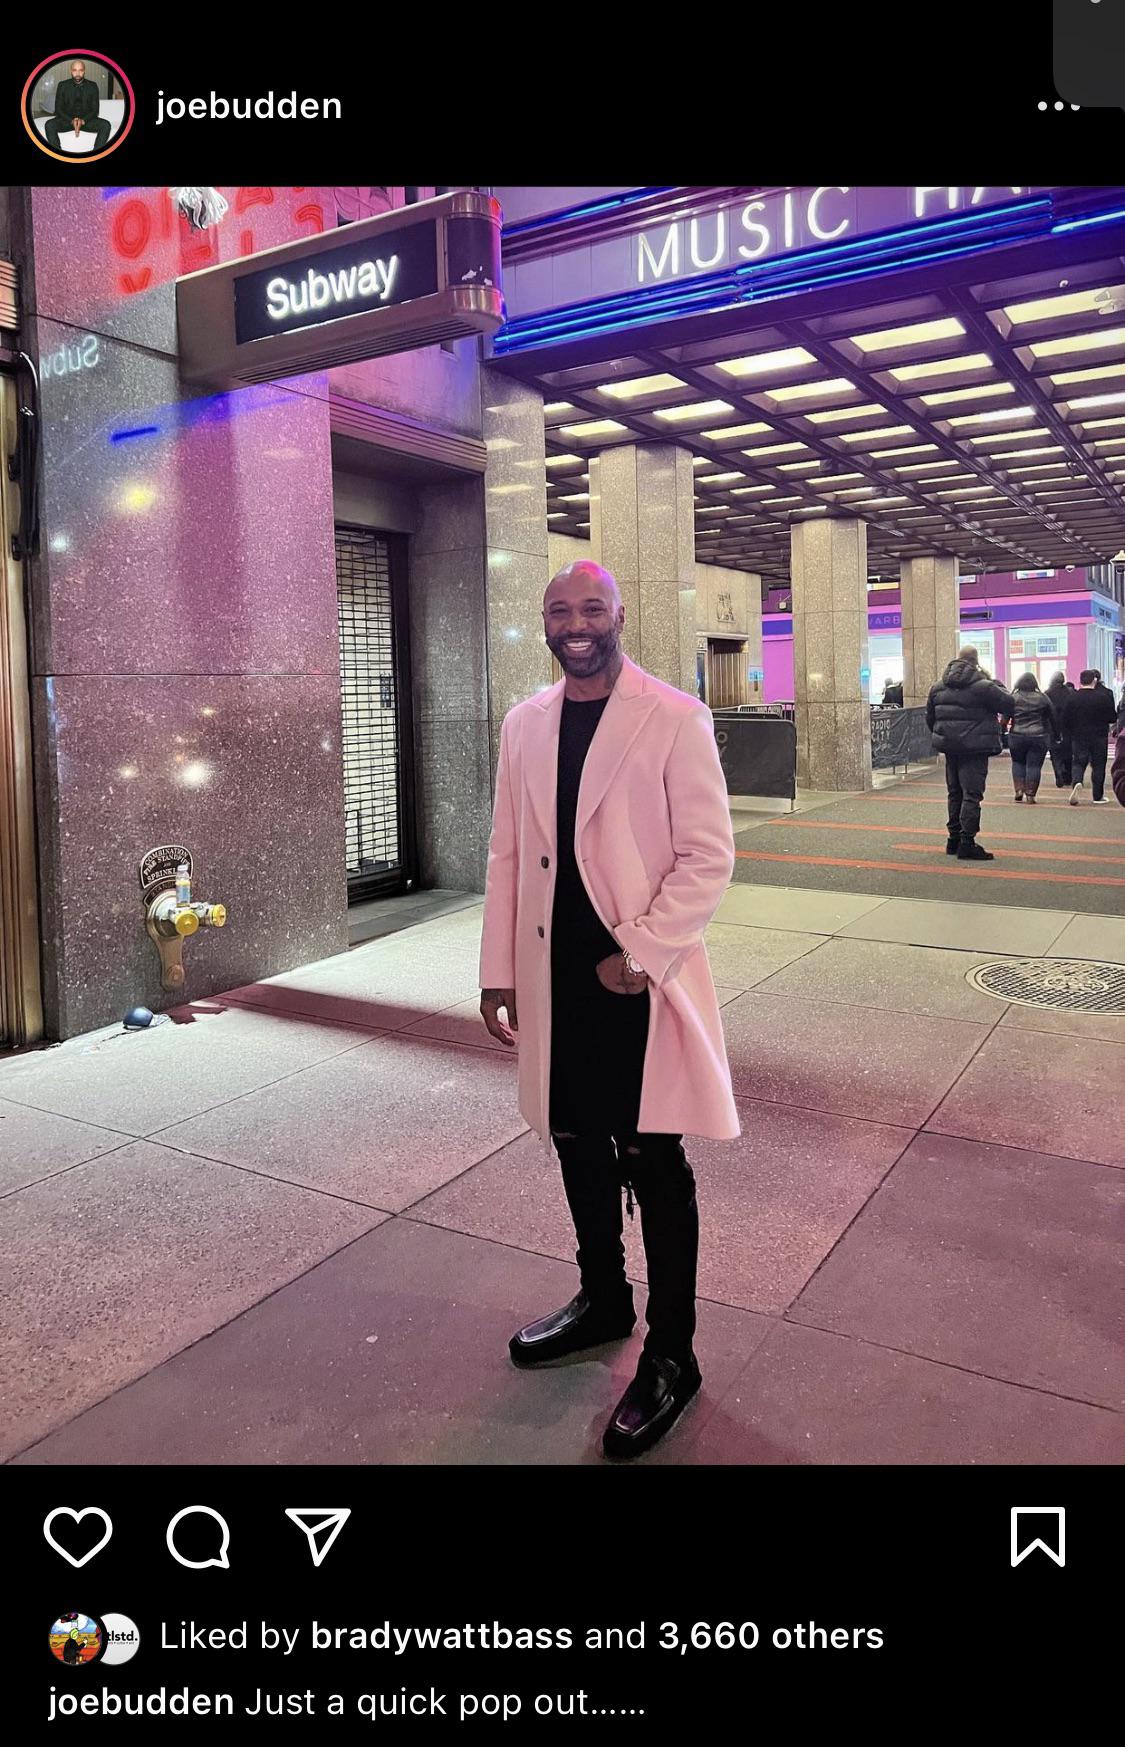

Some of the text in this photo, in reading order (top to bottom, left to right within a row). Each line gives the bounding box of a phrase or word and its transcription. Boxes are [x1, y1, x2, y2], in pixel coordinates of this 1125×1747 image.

[636, 187, 850, 283] MUSIC
[266, 254, 399, 320] Subway
[147, 868, 177, 881] SPRINKL
